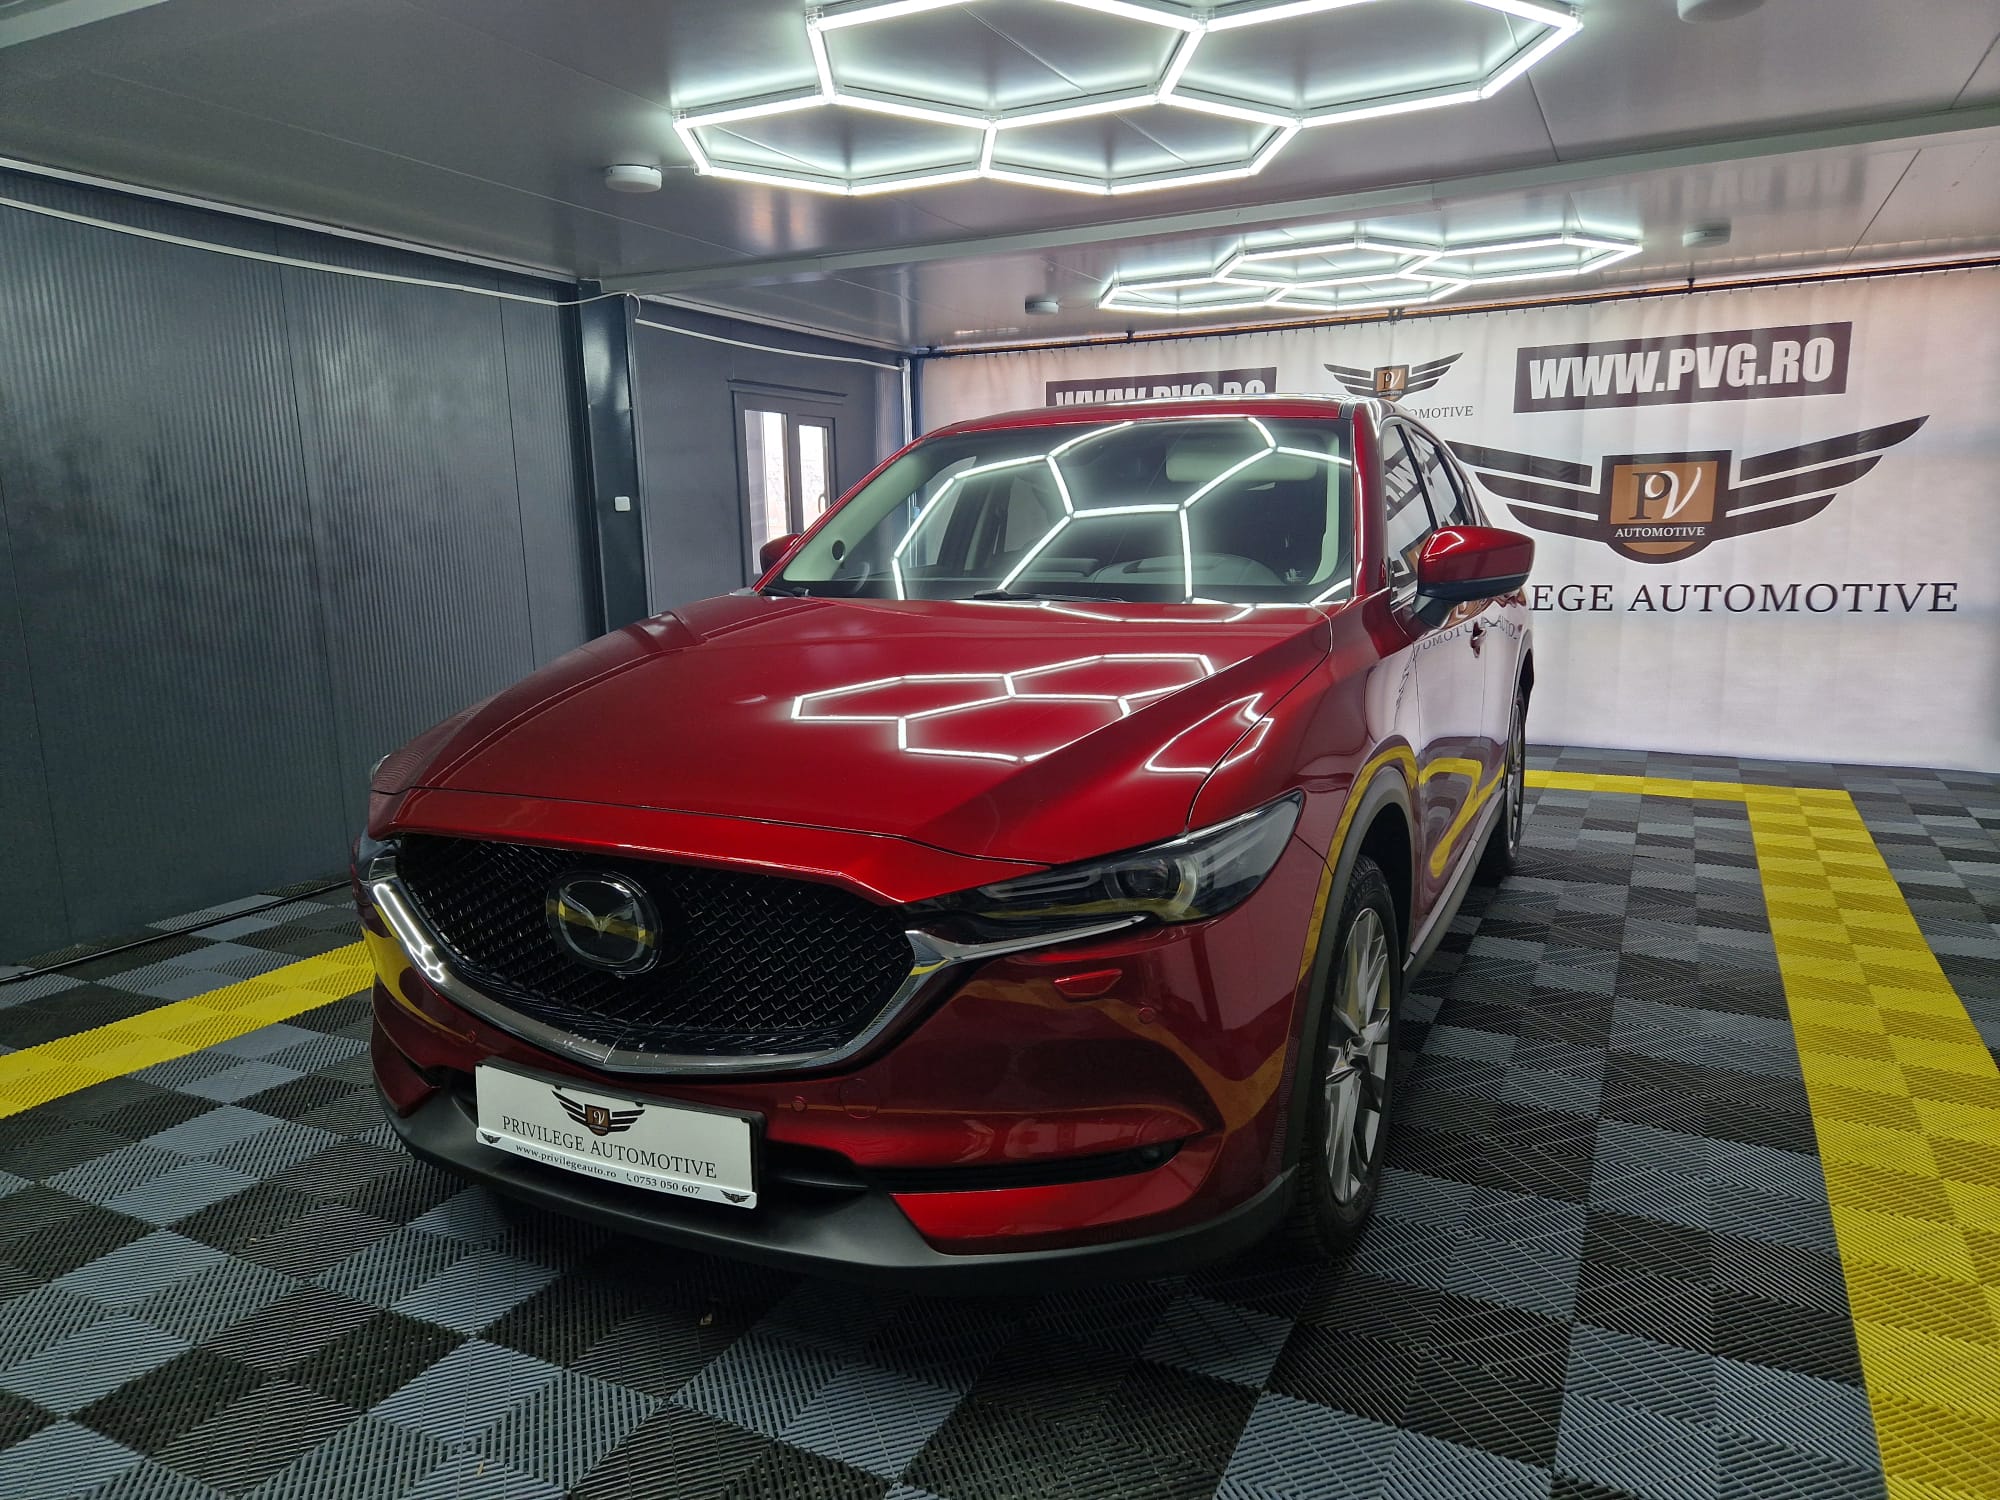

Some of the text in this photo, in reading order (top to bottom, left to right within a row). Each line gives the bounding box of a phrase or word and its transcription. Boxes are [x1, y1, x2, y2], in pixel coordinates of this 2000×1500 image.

[1529, 337, 1835, 400] WWW.PVG.RO
[1409, 406, 1474, 419] OMOTIVE
[1628, 467, 1702, 520] PV
[1614, 527, 1706, 538] AUTOMOTIVE
[1529, 581, 1959, 613] EGE AUTOMOTIVE
[502, 1115, 717, 1179] PRIVILEGE AUTOMOTIVE
[515, 1144, 701, 1195] www.privilegeauto.ro 0753 050 607
